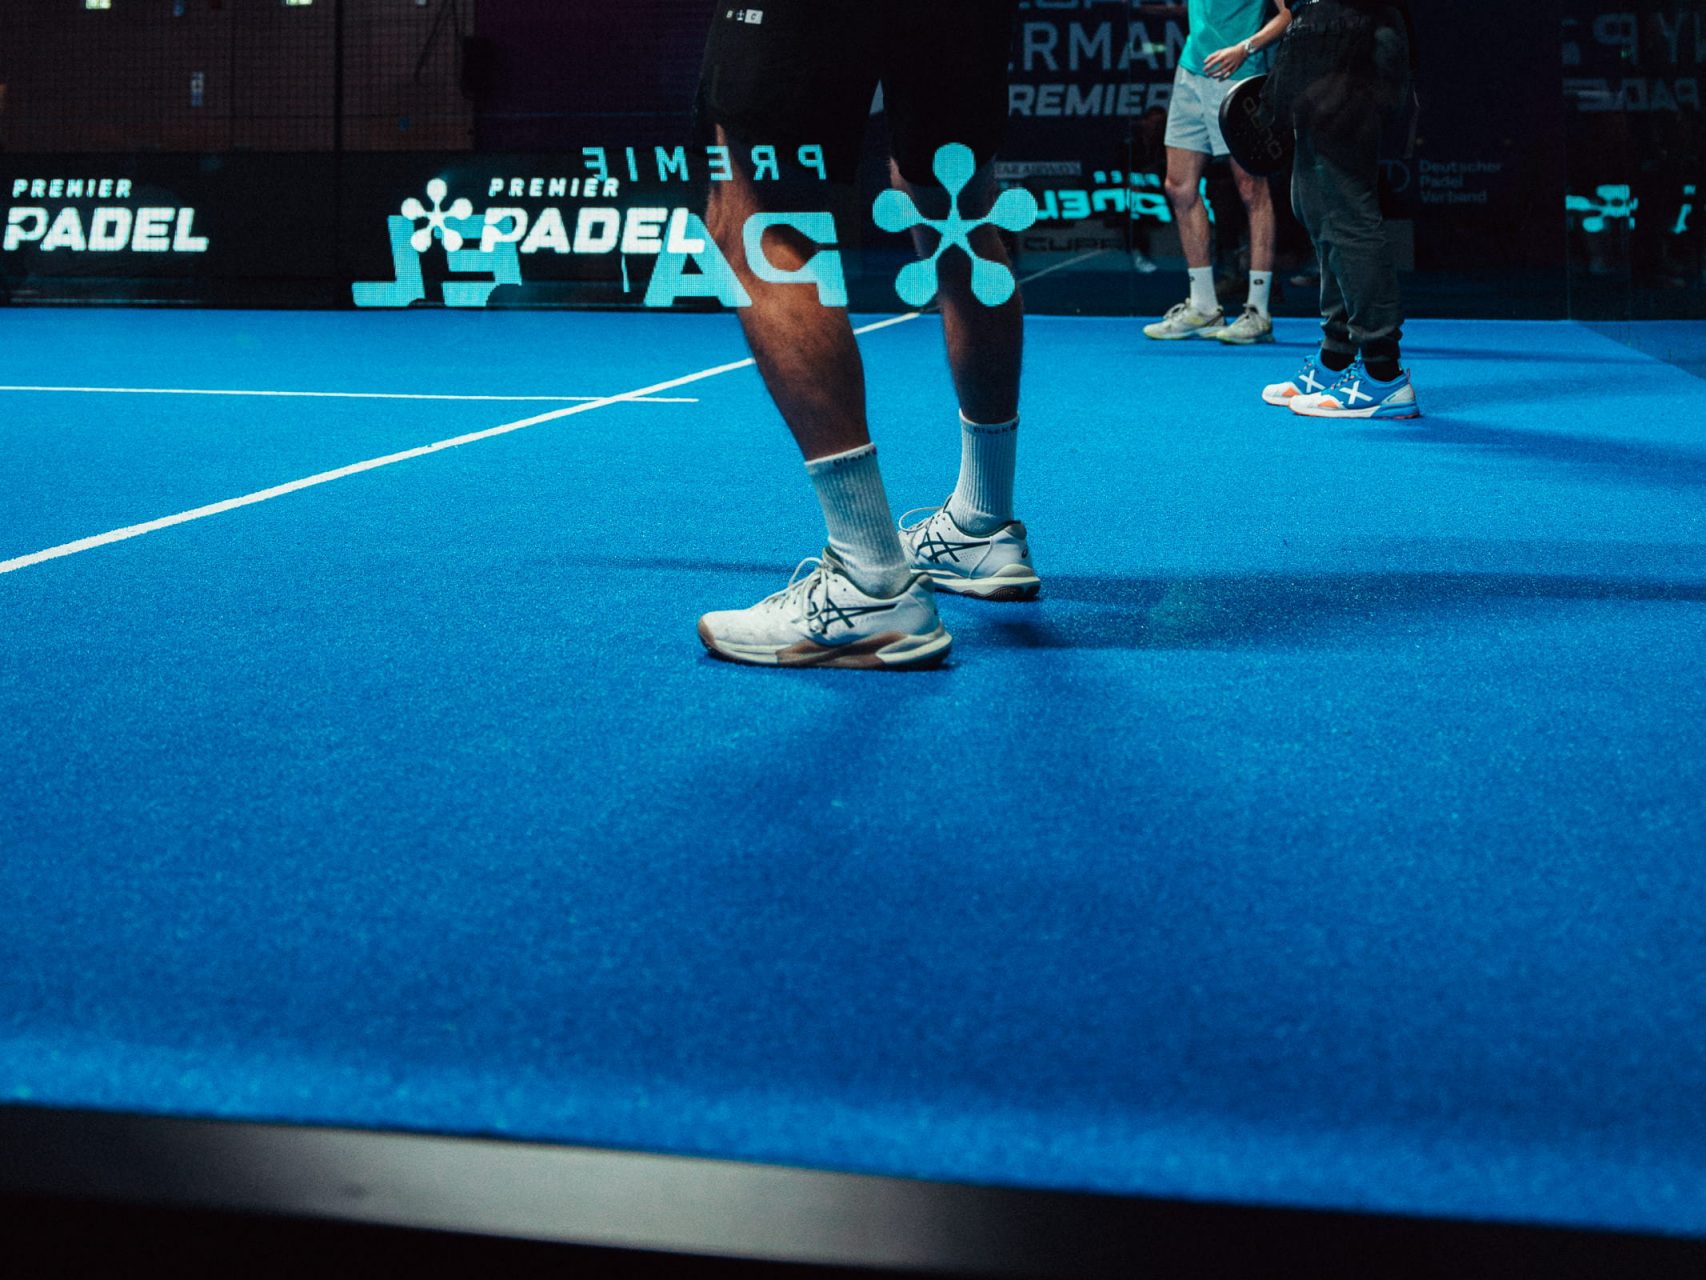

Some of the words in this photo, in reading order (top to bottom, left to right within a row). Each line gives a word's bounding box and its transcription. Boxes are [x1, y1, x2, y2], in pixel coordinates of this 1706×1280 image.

[1008, 20, 1187, 72] RMAN
[1419, 159, 1503, 174] Deutscher
[11, 177, 133, 199] PREMIER
[488, 177, 620, 198] PREMIER
[3, 206, 210, 253] PADEL
[479, 207, 706, 254] PADEL
